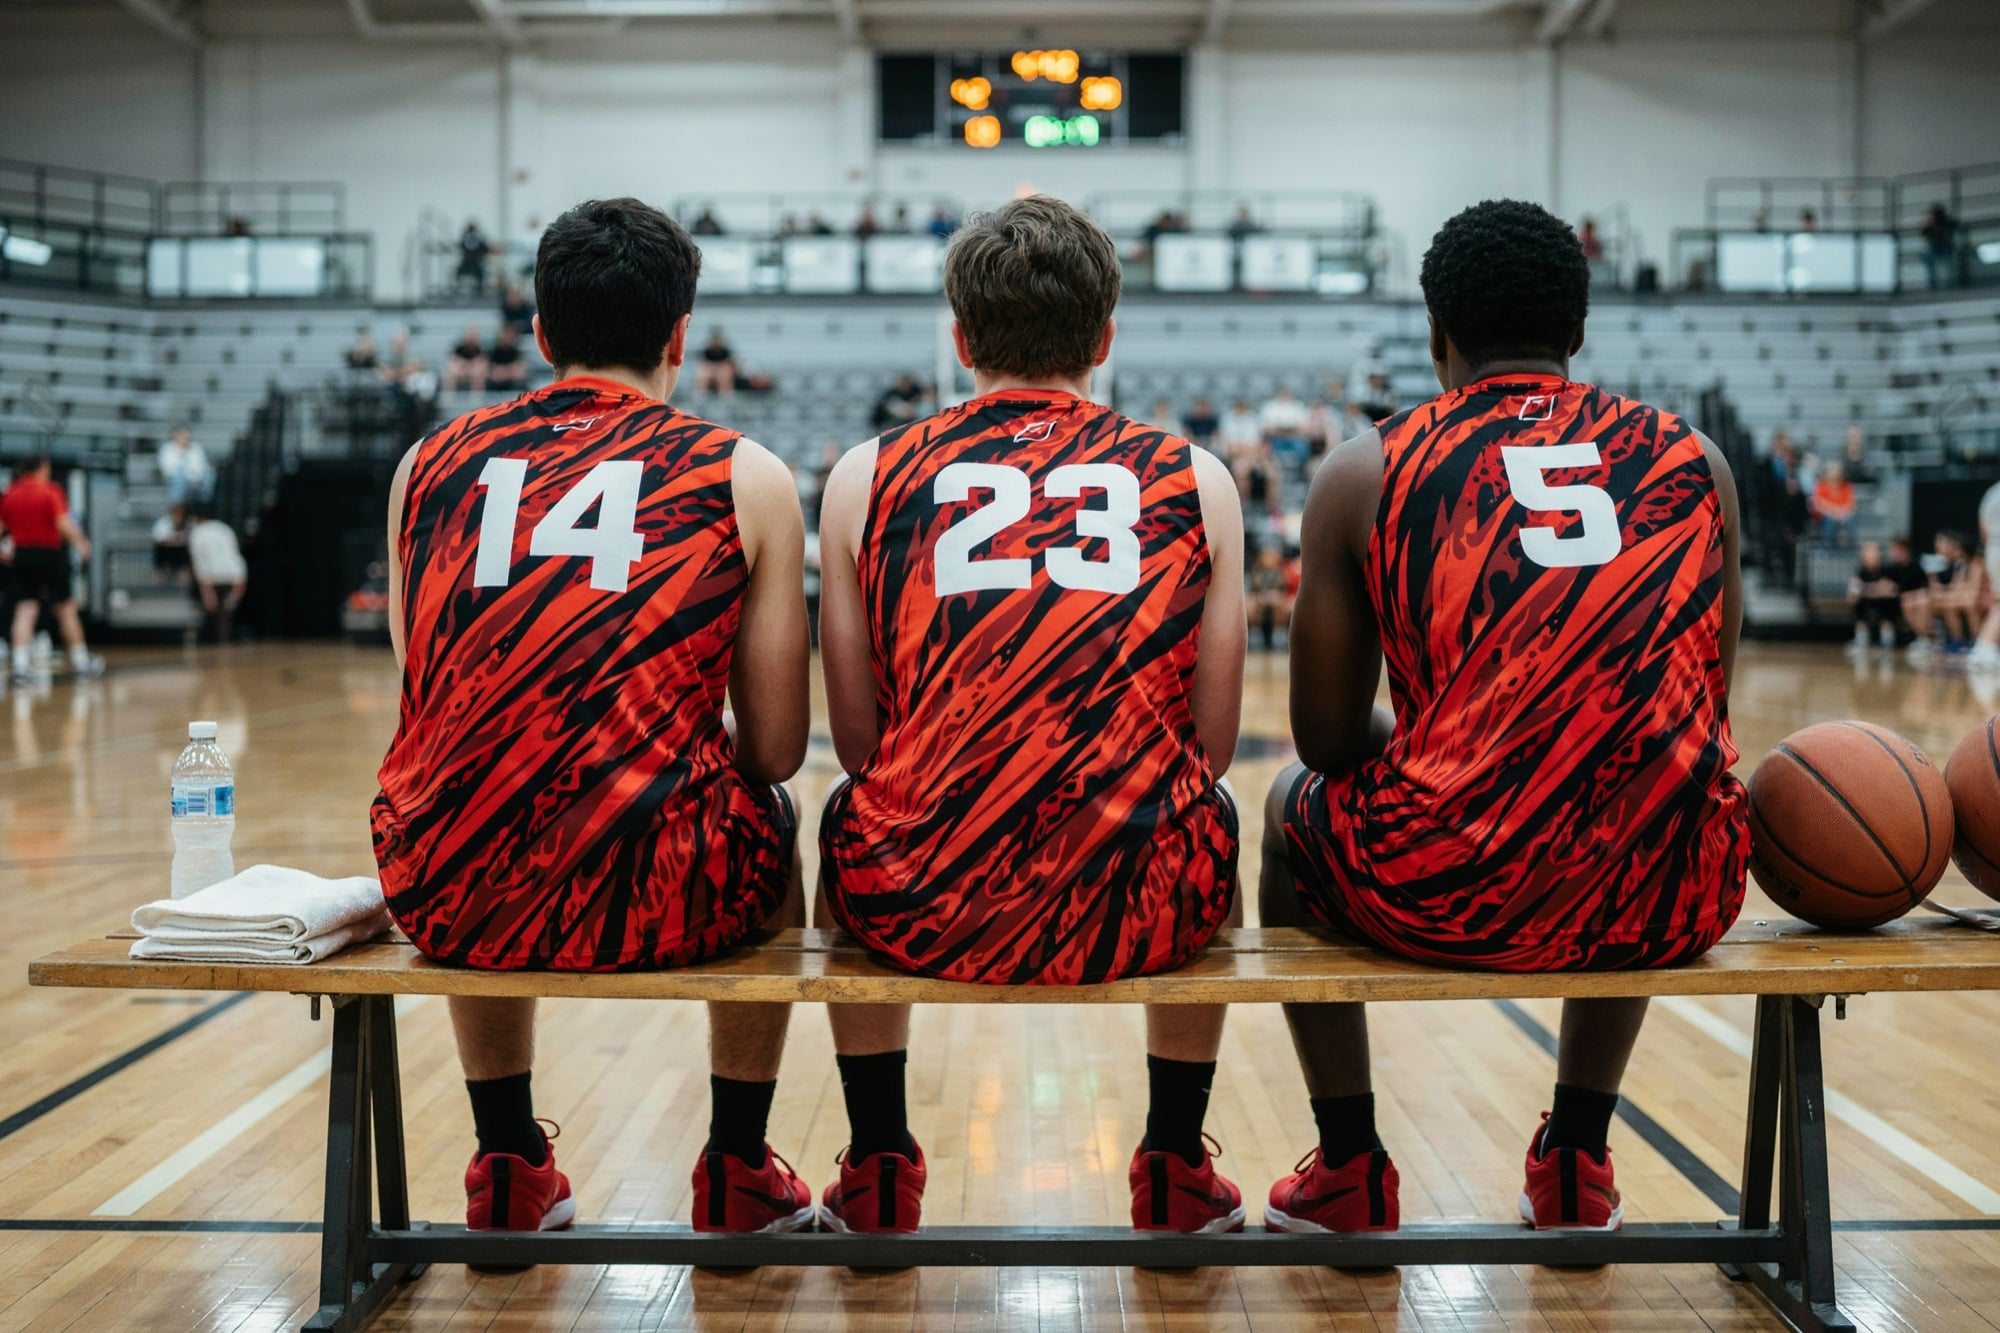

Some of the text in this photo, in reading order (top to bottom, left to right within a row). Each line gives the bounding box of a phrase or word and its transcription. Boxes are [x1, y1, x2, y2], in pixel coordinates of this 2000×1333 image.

[473, 457, 645, 593] 14
[933, 462, 1141, 598] 23
[1500, 442, 1622, 568] 5
